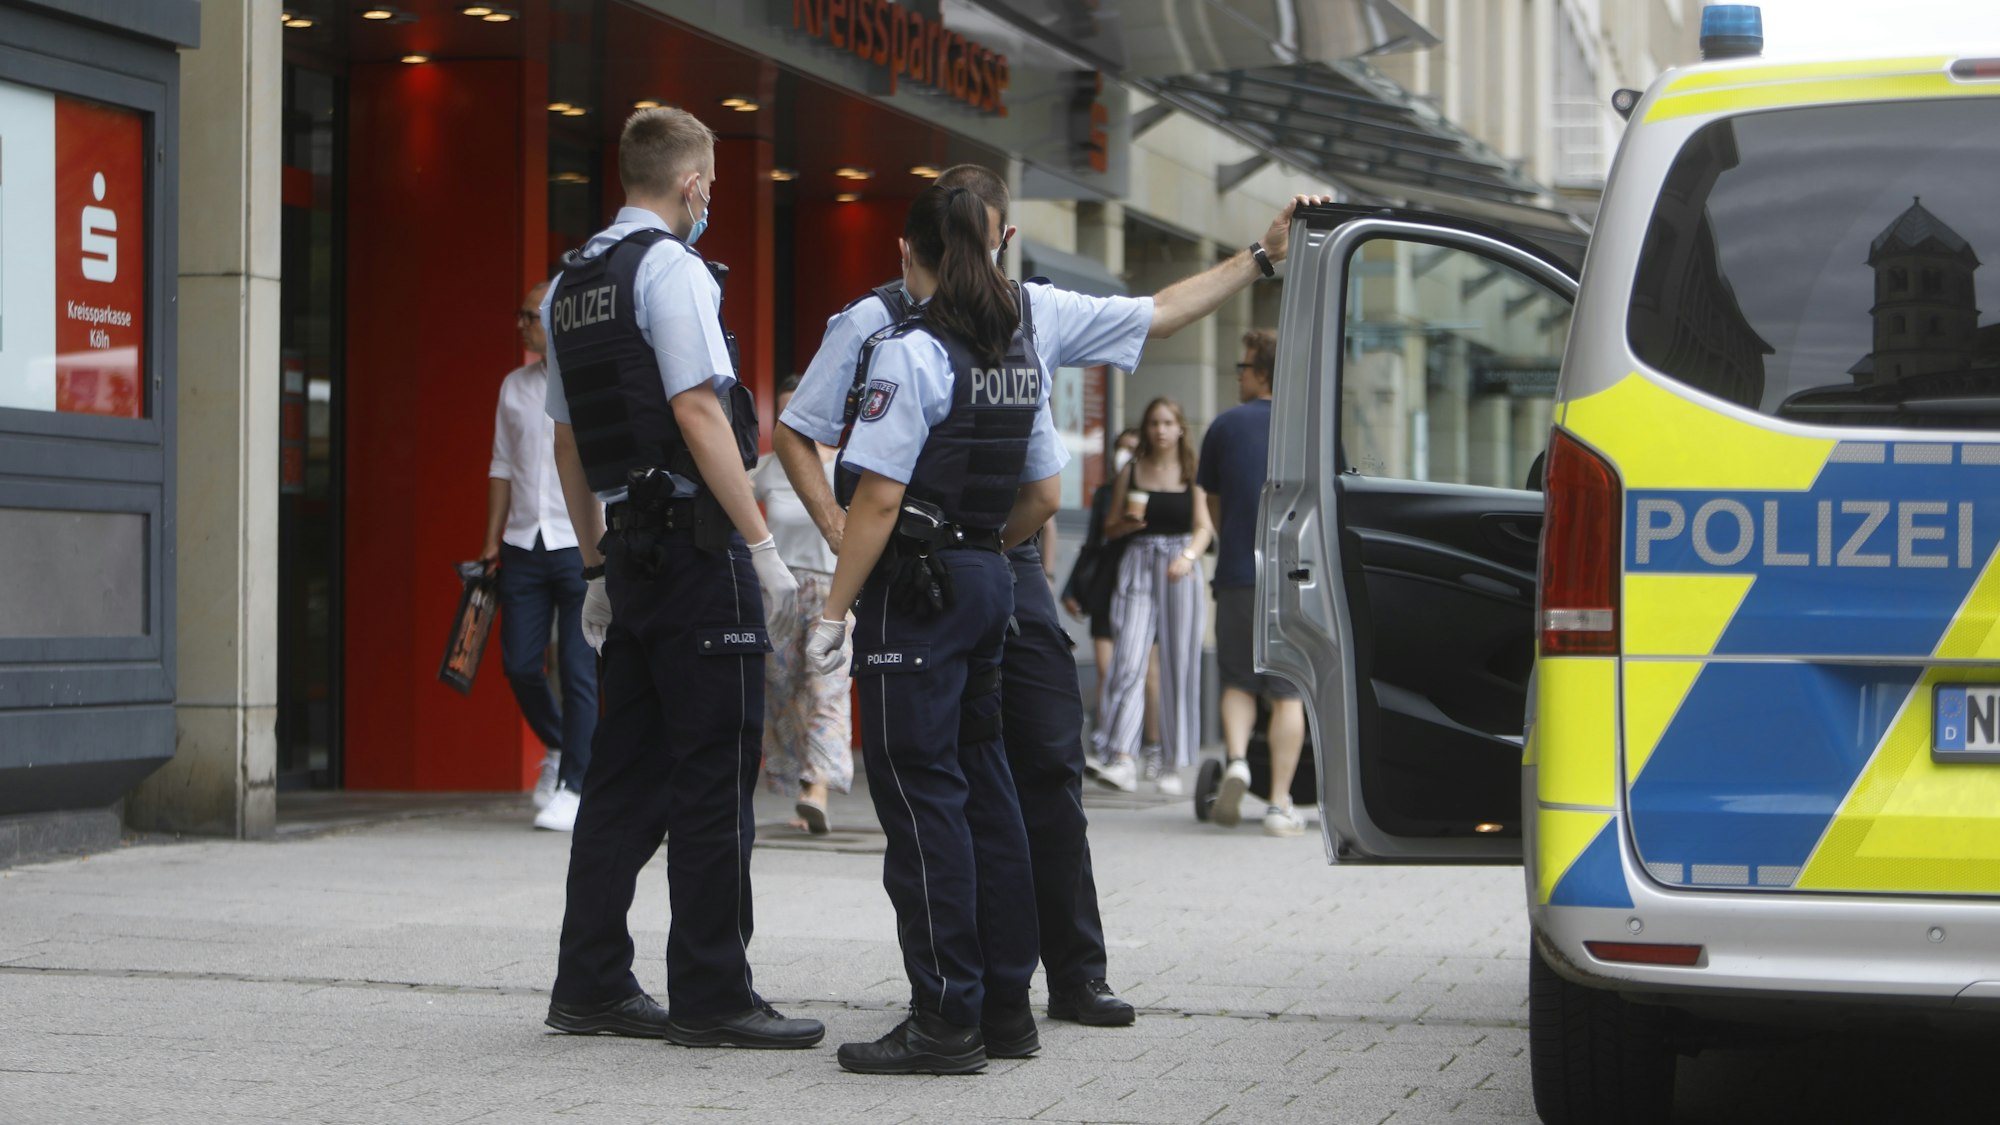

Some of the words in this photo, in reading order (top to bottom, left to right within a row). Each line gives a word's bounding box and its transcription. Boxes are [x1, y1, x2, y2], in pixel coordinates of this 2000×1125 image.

[67, 299, 132, 327] Kreissparkasse
[554, 284, 617, 336] POLIZEI
[89, 328, 110, 350] Köln
[970, 367, 1040, 405] POLIZEI
[1635, 498, 1974, 569] POLIZEI
[723, 632, 756, 645] POLIZEI
[867, 652, 903, 666] POLIZEI
[1944, 726, 1957, 741] D
[1966, 694, 2000, 745] N
